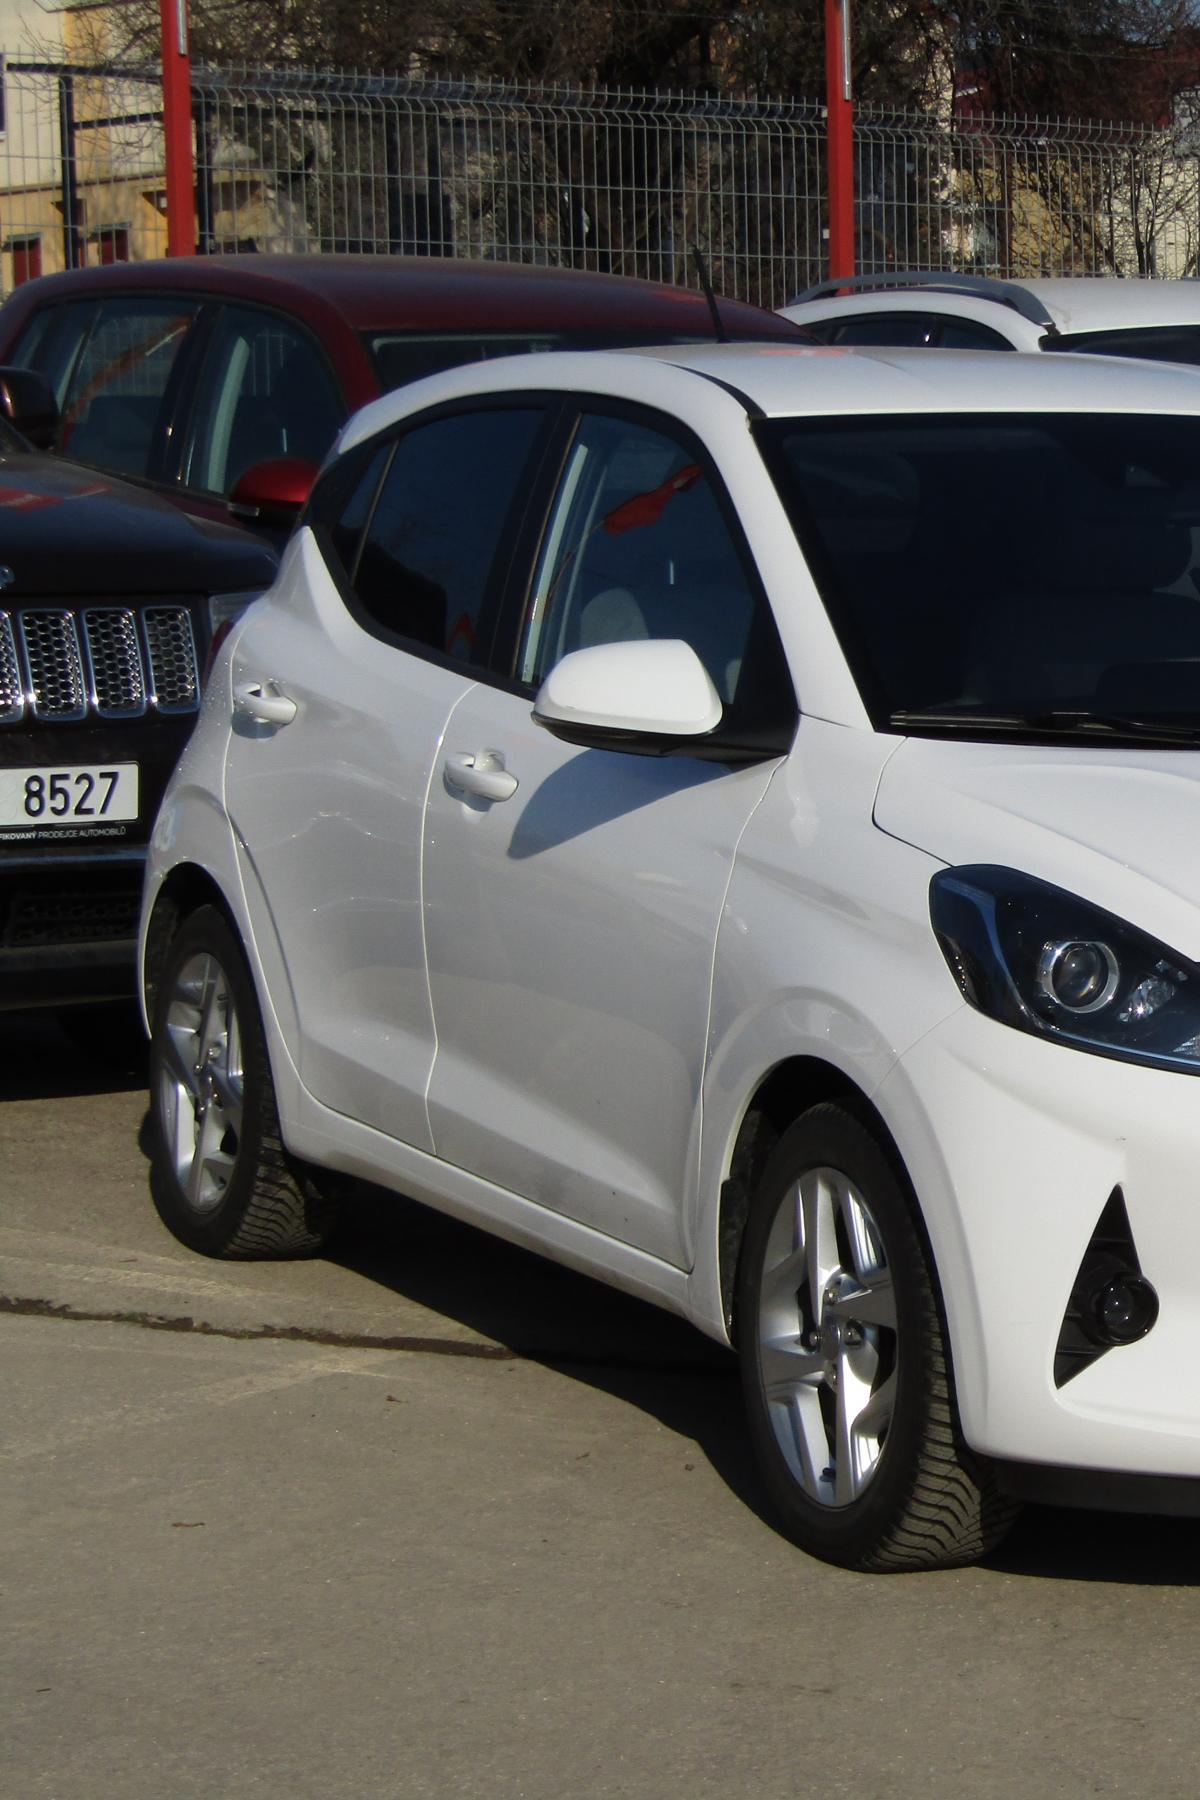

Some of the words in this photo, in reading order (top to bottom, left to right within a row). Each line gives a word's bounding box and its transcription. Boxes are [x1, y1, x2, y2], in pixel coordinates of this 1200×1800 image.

[24, 771, 119, 817] 8527
[38, 828, 78, 839] PRODEJCE
[79, 826, 126, 837] AUTOMOBILŮ
